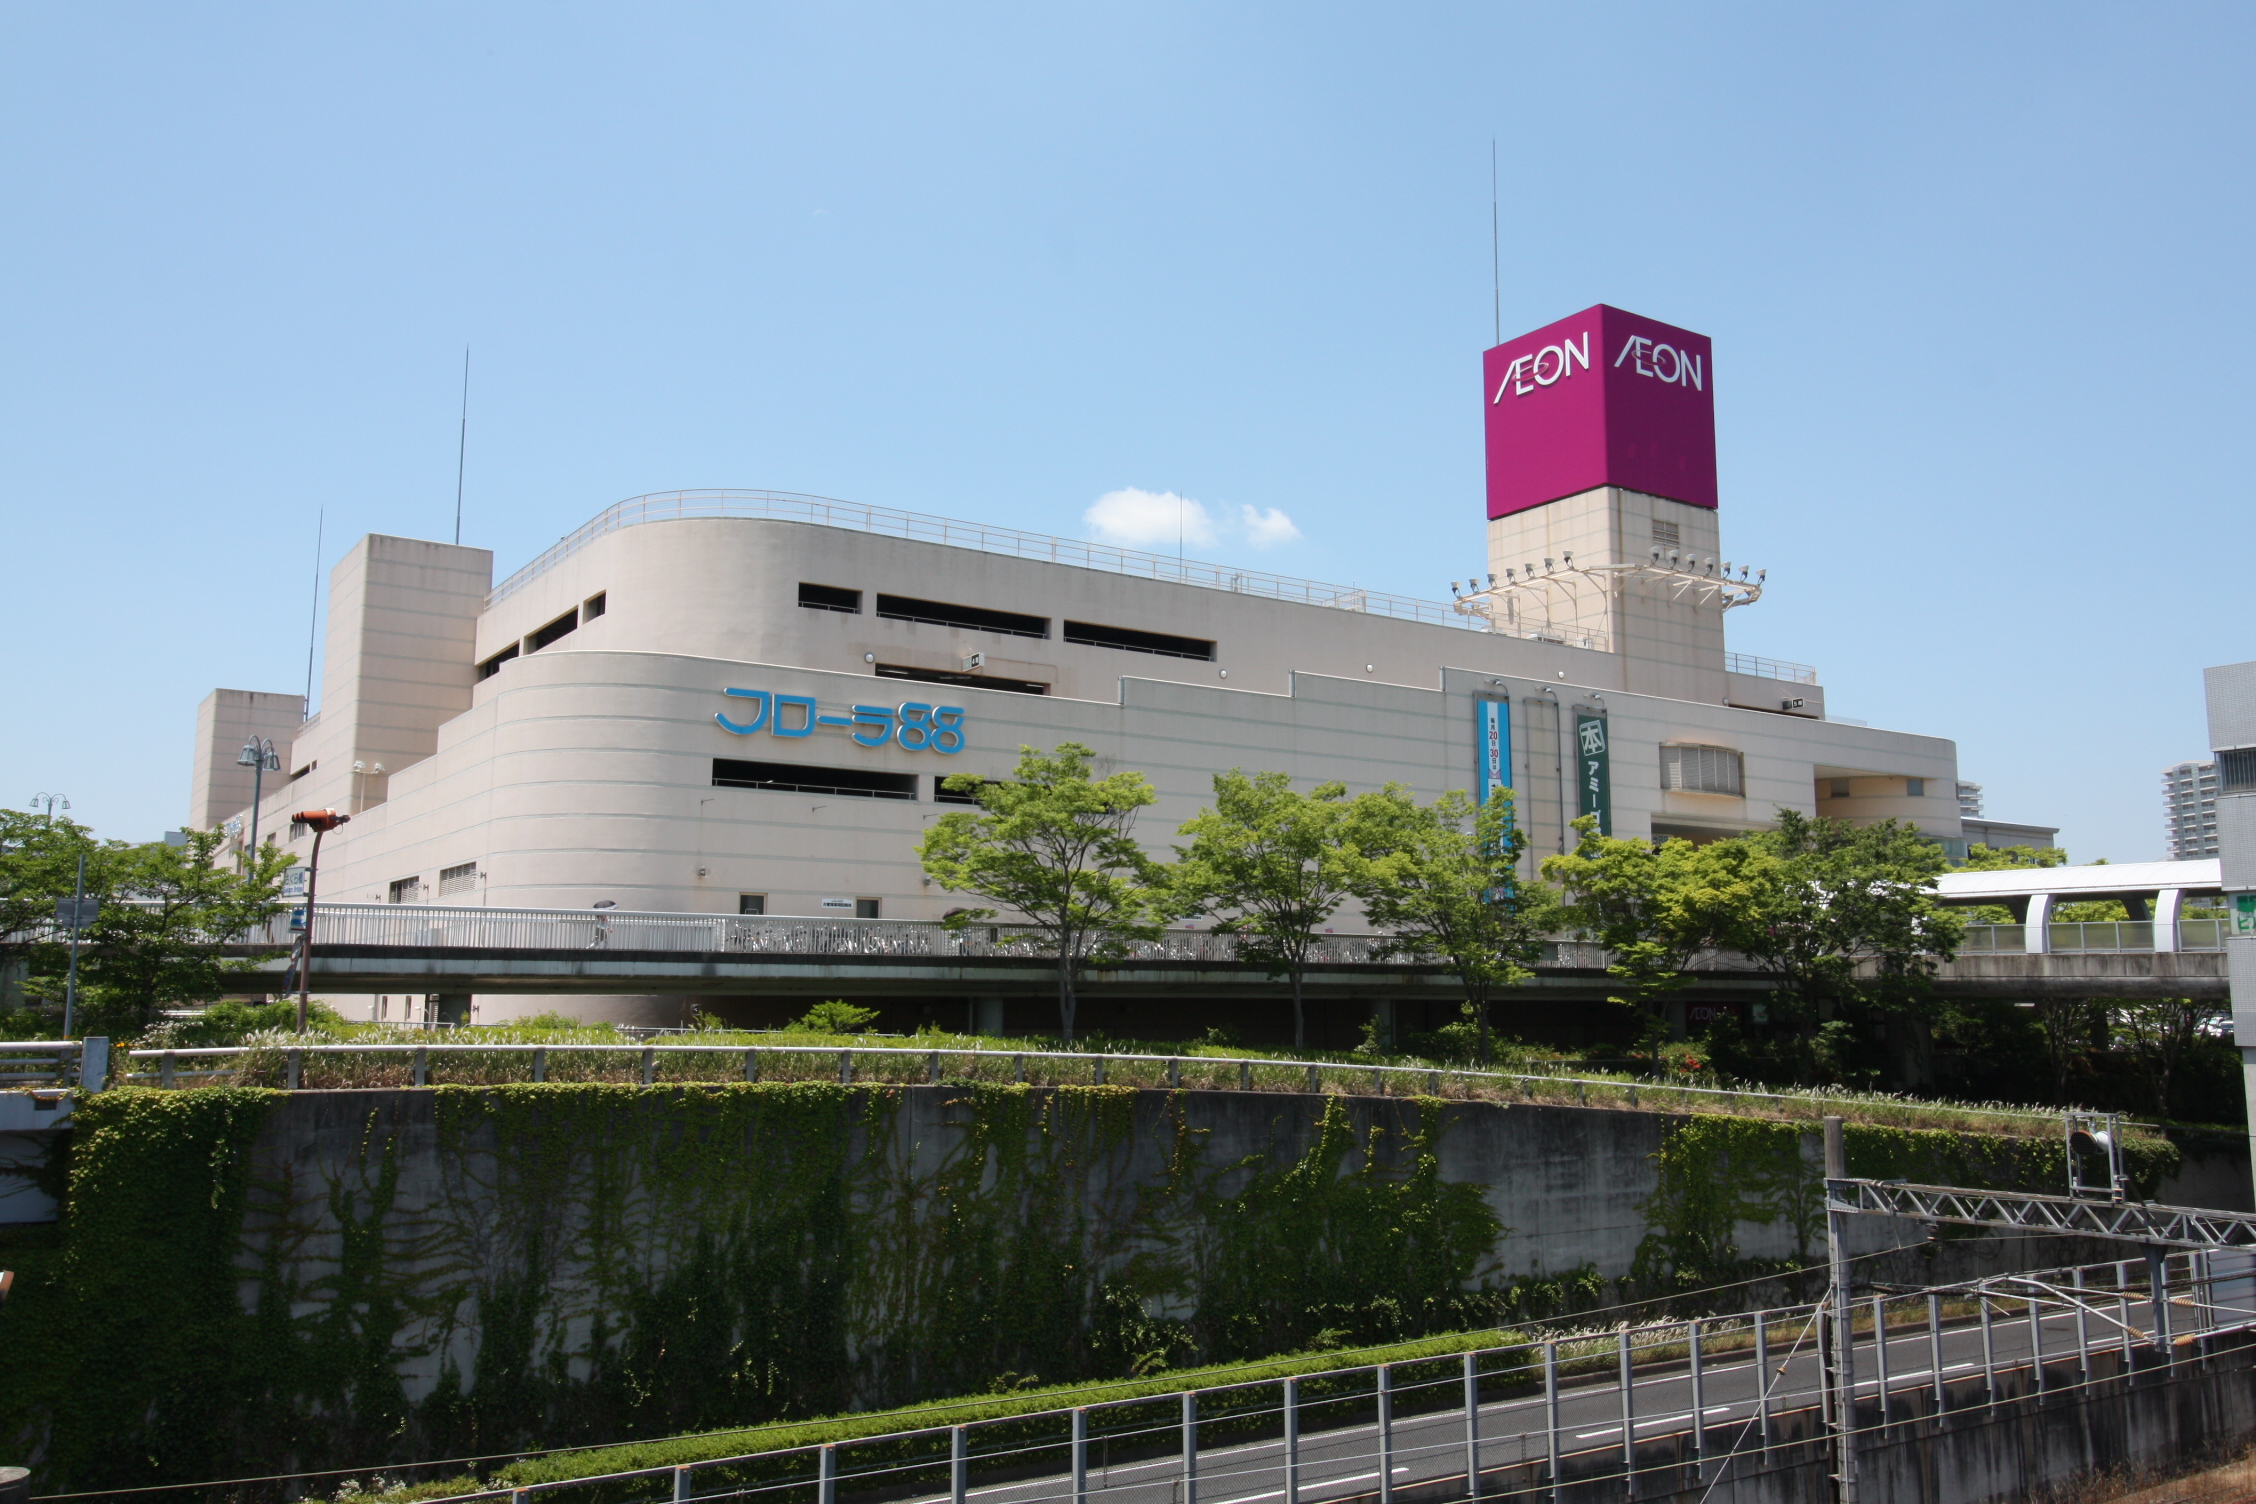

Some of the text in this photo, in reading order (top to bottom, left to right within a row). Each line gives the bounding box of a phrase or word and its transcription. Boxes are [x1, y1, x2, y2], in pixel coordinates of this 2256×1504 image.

[714, 687, 966, 754] フローラ88
[1581, 726, 1602, 754] 本
